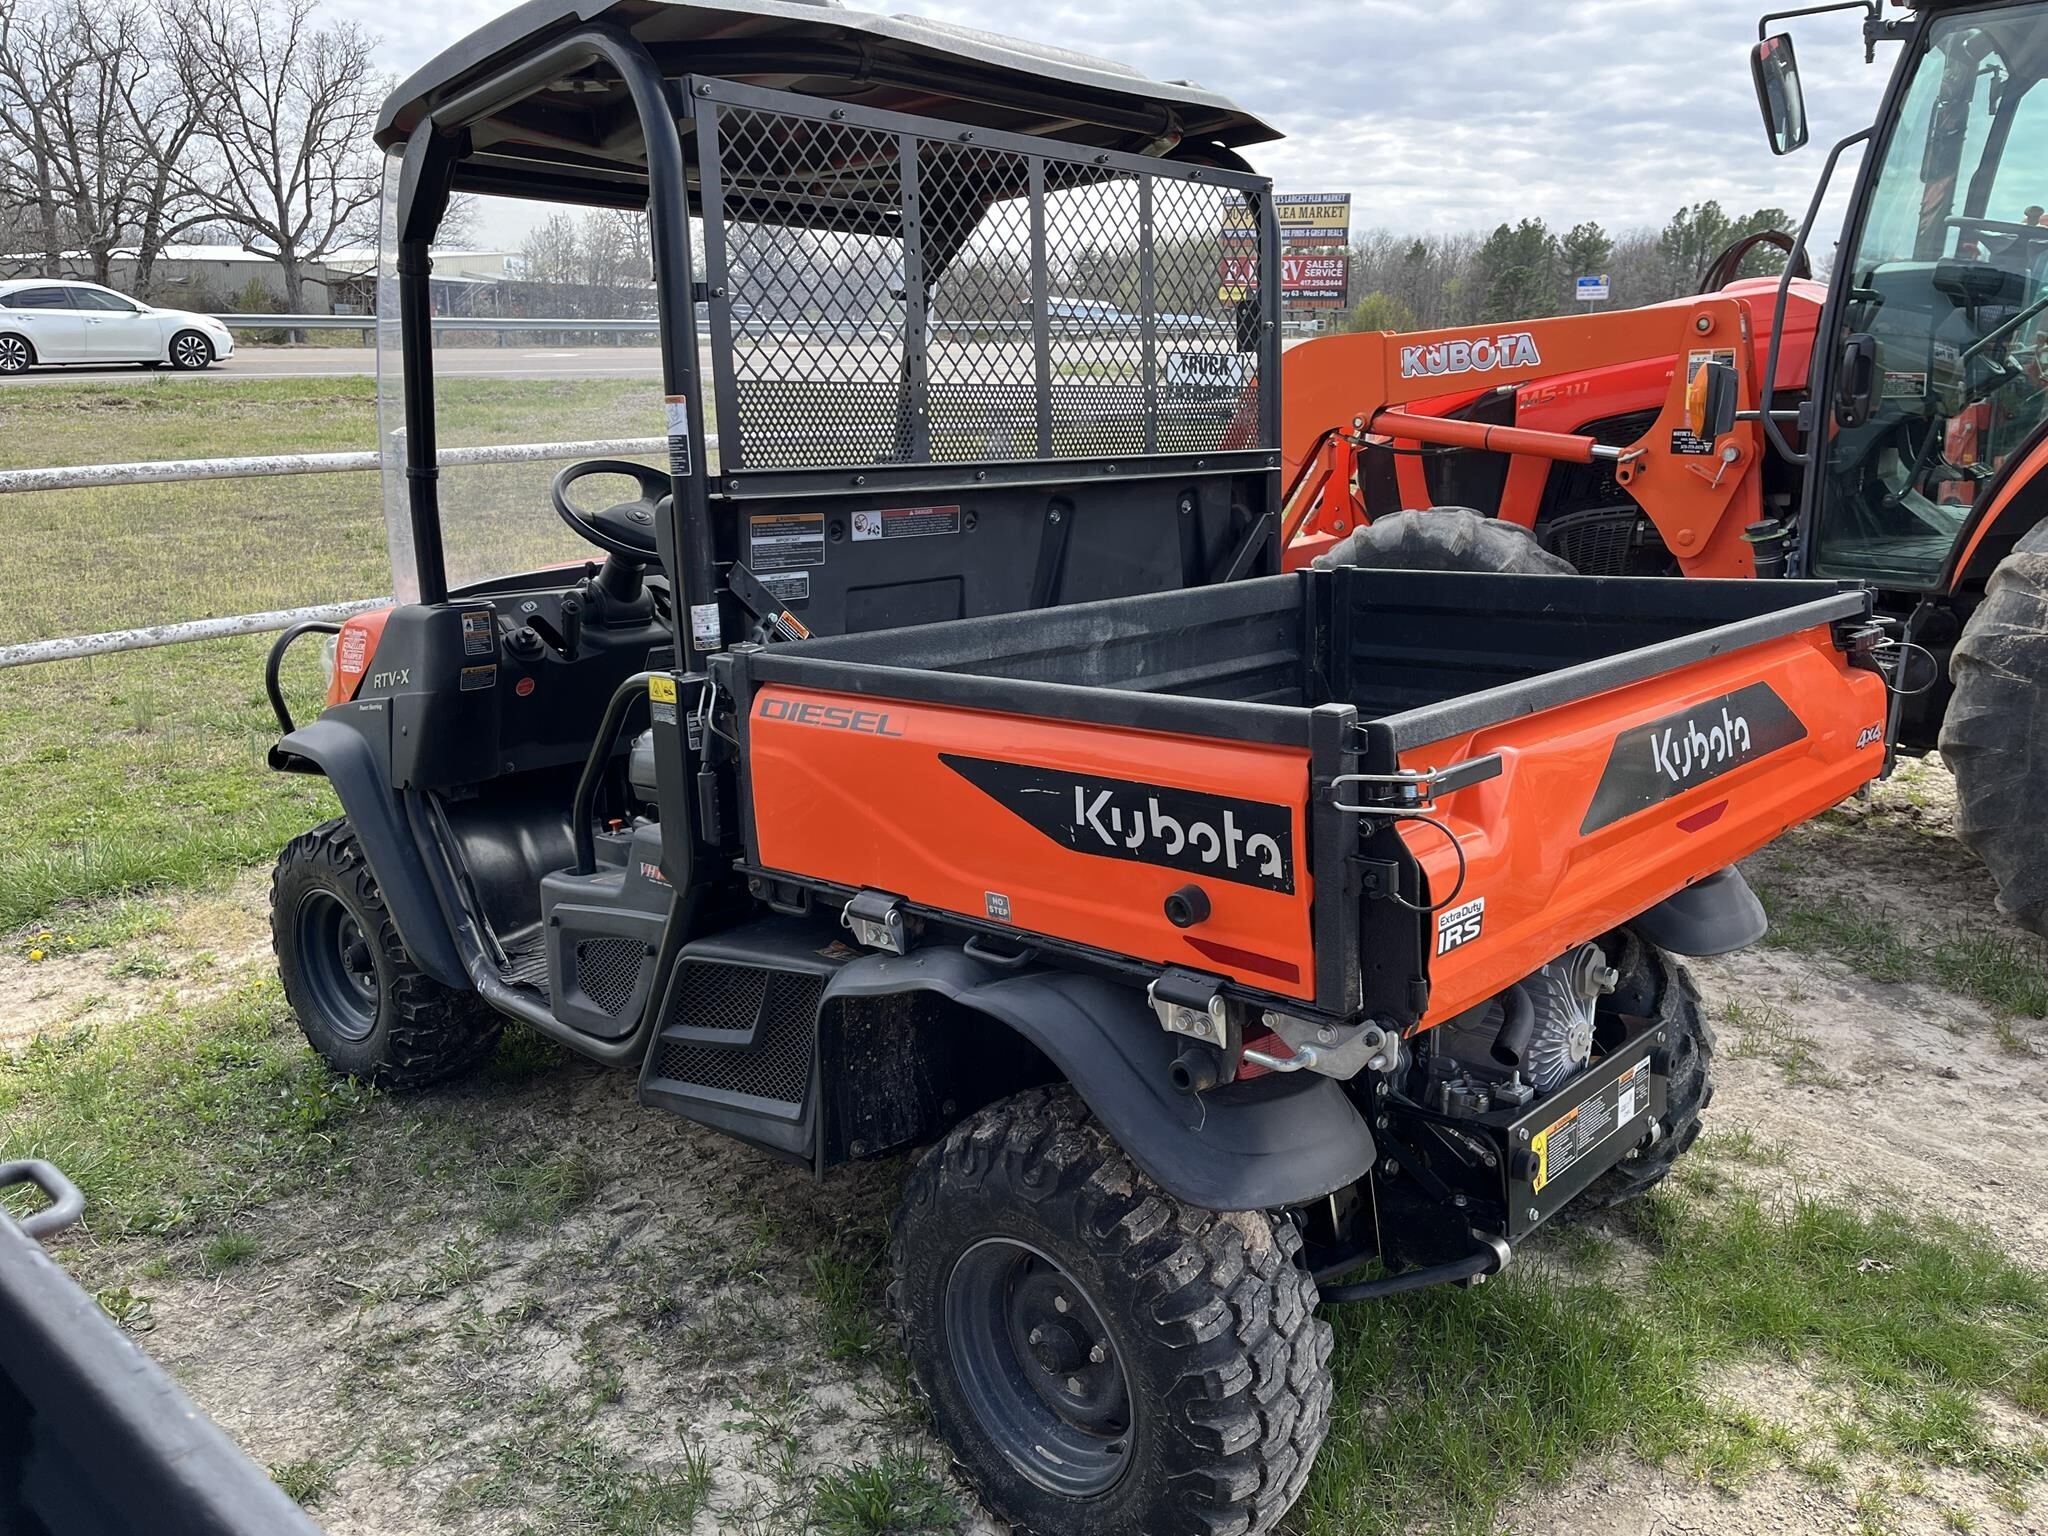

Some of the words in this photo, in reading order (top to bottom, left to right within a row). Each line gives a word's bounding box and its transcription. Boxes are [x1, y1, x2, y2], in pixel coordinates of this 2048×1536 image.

[1323, 193, 1345, 202] MARKET
[1298, 205, 1345, 219] MARKET
[1304, 268, 1343, 277] SERVICE
[1306, 260, 1335, 269] SALES
[1336, 260, 1343, 269] &
[1291, 289, 1299, 297] 63
[1319, 289, 1338, 297] Plains
[1182, 354, 1229, 376] TRUCK
[1402, 334, 1539, 377] KUBOTA
[373, 668, 410, 689] RTV-X
[759, 698, 904, 737] DIESEL
[1650, 707, 1751, 782] Kubota
[1074, 785, 1283, 879] Kubota
[988, 904, 1008, 917] STEP
[991, 896, 1004, 906] NO
[1440, 910, 1461, 927] Extra
[1461, 901, 1482, 917] Duty
[1437, 915, 1482, 955] IRS
